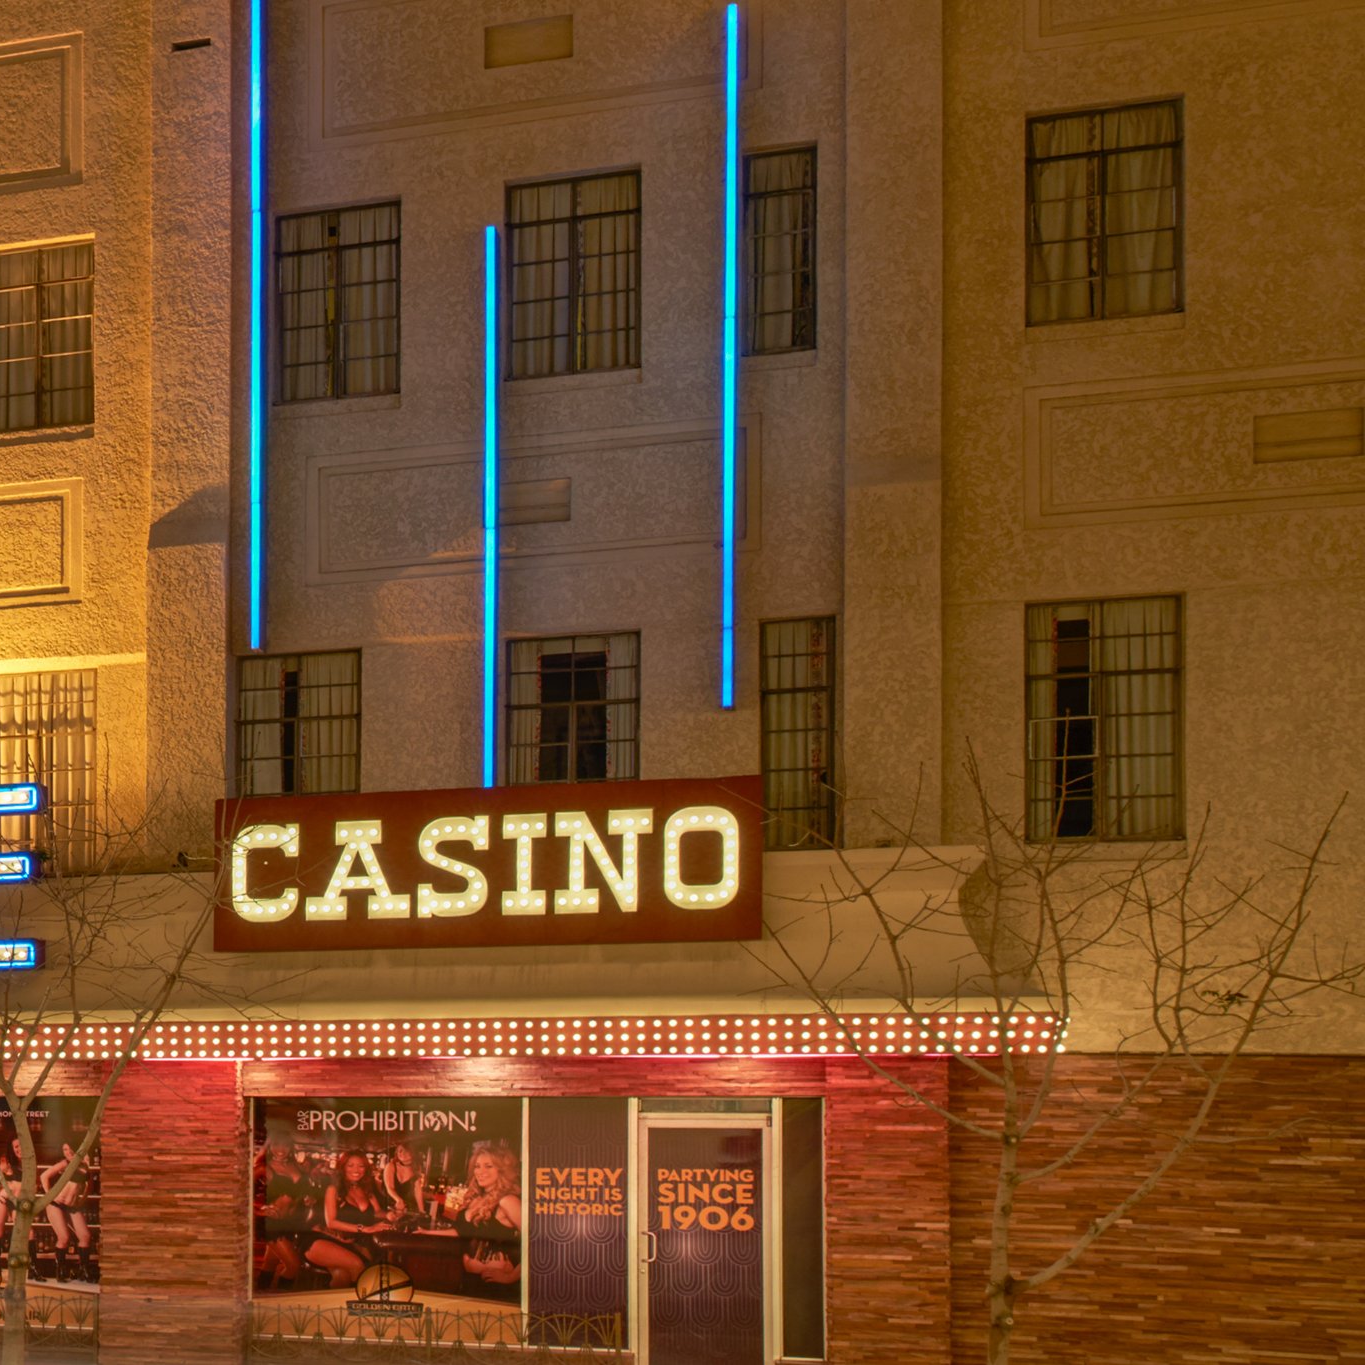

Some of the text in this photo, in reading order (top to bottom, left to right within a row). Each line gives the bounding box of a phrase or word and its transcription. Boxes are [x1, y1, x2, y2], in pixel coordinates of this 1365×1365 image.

[232, 805, 739, 923] CASINO
[297, 1110, 477, 1132] BAR PROHIBITION!
[535, 1167, 623, 1186] EVERY
[657, 1168, 754, 1182] PARTYING
[535, 1187, 623, 1201] NIGHT IS
[658, 1183, 754, 1204] SINCE
[535, 1202, 623, 1216] HISTORIC
[657, 1205, 755, 1231] 1906
